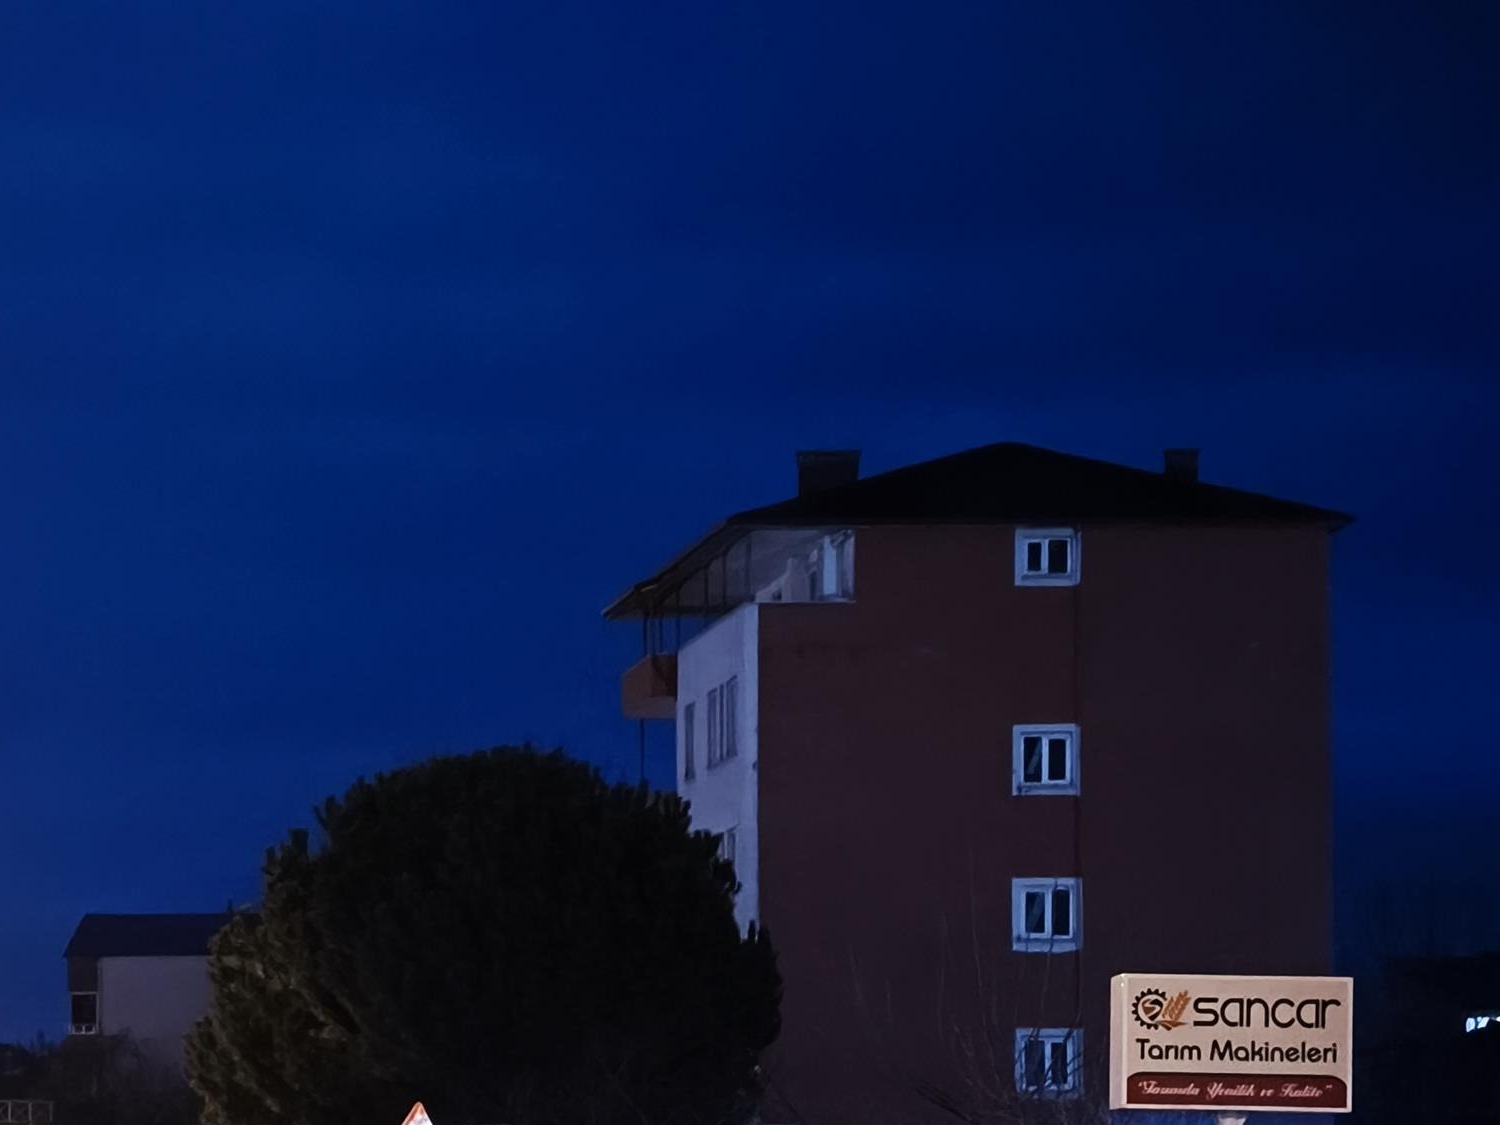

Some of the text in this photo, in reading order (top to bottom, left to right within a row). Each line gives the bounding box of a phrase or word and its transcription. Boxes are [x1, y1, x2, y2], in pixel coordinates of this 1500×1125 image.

[1192, 997, 1342, 1029] sancar
[1135, 1038, 1338, 1063] Tarım Makineleri
